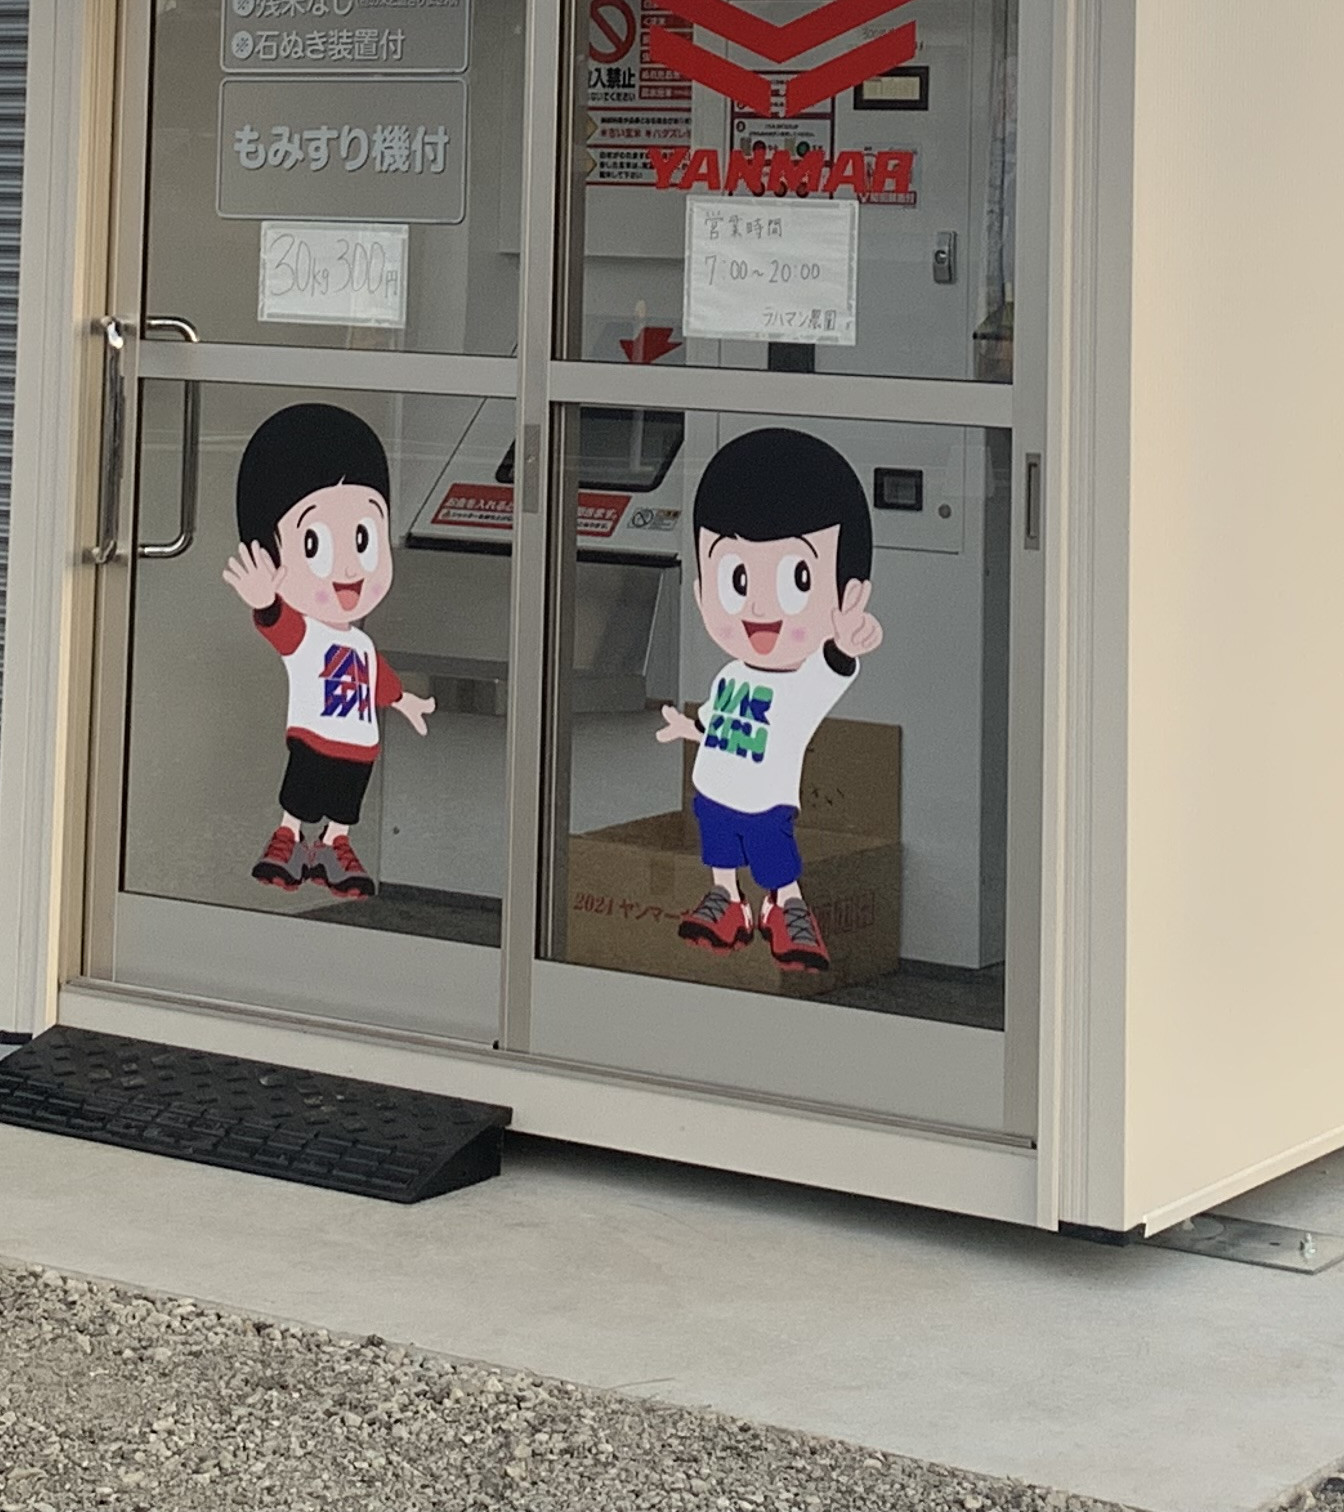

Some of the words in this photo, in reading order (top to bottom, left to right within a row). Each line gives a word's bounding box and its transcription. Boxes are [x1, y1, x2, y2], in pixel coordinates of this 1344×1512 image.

[256, 28, 405, 61] 石ぬき装置付
[233, 124, 450, 174] もみすり機付
[645, 146, 915, 193] YANMAR
[704, 210, 783, 240] 営業時間
[618, 898, 690, 924] ヤンマー
